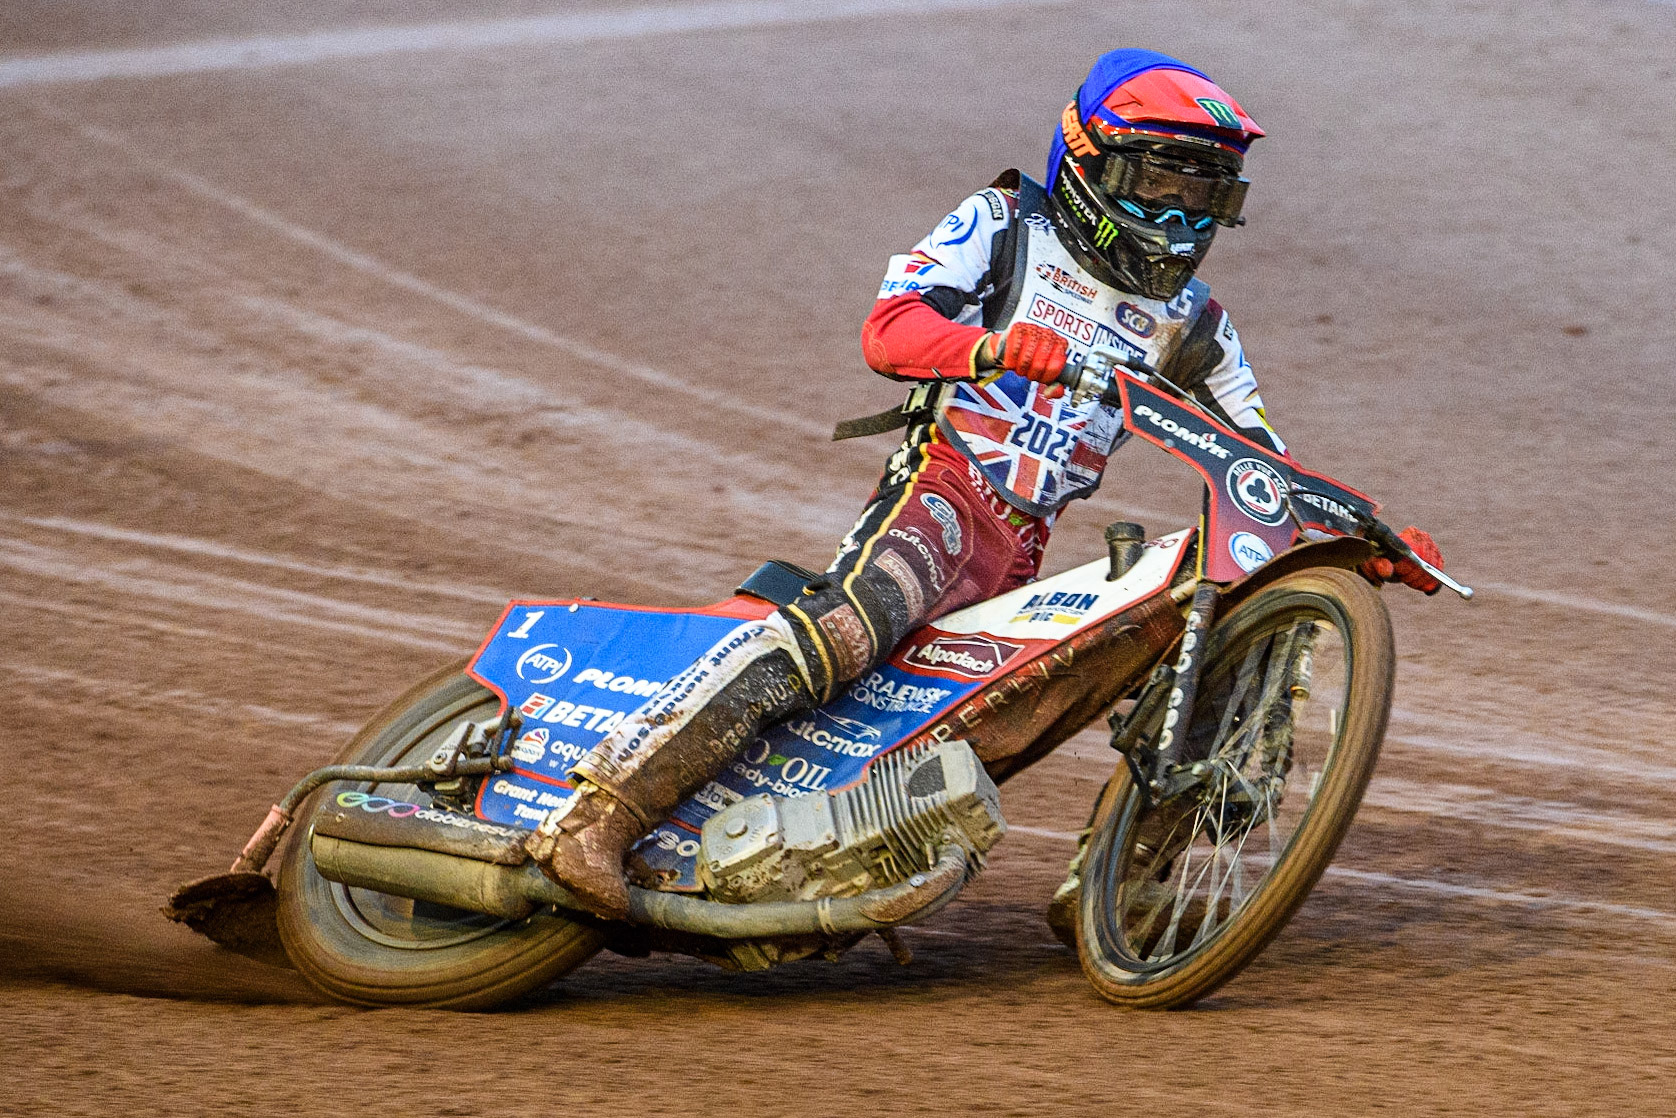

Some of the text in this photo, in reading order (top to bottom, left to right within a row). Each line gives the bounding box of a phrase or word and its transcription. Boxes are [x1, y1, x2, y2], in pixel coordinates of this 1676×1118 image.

[1051, 270, 1099, 300] BRITISH
[1032, 299, 1095, 342] SPORTS
[1232, 461, 1254, 477] BELLE
[1255, 461, 1274, 477] VUE
[1021, 591, 1100, 612] ALBON
[507, 610, 545, 639] 1
[712, 626, 766, 667] Grant
[916, 643, 995, 674] Alpodach
[526, 652, 563, 675] ATPI
[617, 671, 711, 763] Henderson
[493, 779, 538, 801] Grant
